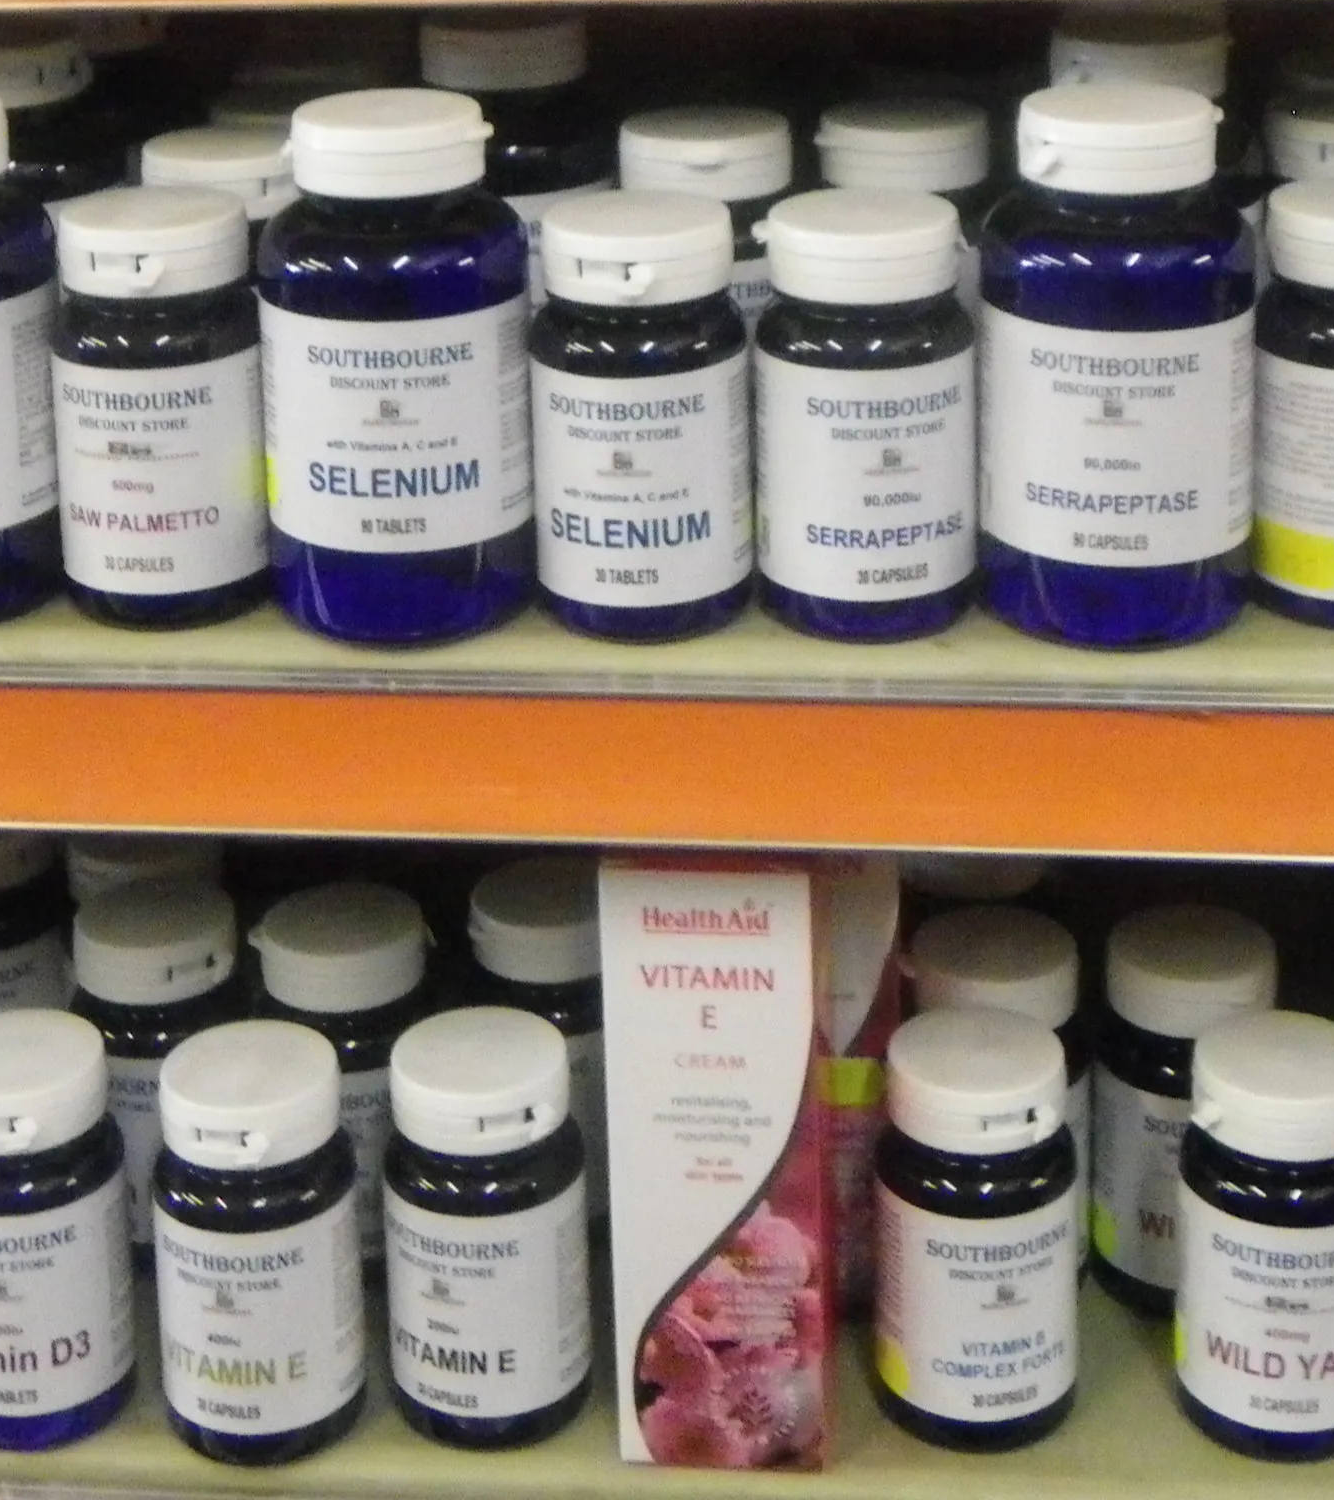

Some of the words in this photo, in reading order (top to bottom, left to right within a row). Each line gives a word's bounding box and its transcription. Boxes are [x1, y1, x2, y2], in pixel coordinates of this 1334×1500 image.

[307, 342, 474, 370] SOUTHBOURNE
[1030, 348, 1200, 378] SOUTHBOURNE
[329, 376, 398, 391] DISCOUNT
[403, 374, 450, 390] STORE
[1052, 380, 1124, 397] DISCOUNT
[1128, 384, 1176, 397] STORE
[63, 385, 213, 411] SOUTHBOURNE
[550, 392, 705, 422] SOUTHBOURNE
[806, 384, 961, 420] SOUTHBOURNE
[428, 439, 447, 449] and
[635, 425, 683, 441] STORE
[309, 459, 481, 498] SELENIUM
[1026, 482, 1199, 515] SERRAPEPTASE
[70, 505, 102, 527] SAW
[107, 505, 219, 533] PALMETTO
[375, 517, 427, 535] TABLETS
[551, 508, 711, 549] SELENIUM
[806, 510, 963, 549] SERRAPEPTASE
[1087, 532, 1148, 551] CAPSULES
[117, 556, 174, 572] CAPSULES
[609, 568, 659, 586] TABLETS
[640, 964, 775, 991] VITAMIN
[701, 1005, 717, 1030] E
[674, 1054, 747, 1068] CREAM
[745, 1115, 771, 1126] and
[676, 1131, 750, 1146] nourishing
[51, 1331, 91, 1367] D3
[393, 1326, 487, 1374] VITAMIN
[498, 1349, 517, 1373] E
[962, 1336, 1027, 1357] VITAMIN
[1206, 1329, 1285, 1382] WILD
[167, 1344, 276, 1387] VITAMIN
[288, 1351, 307, 1380] E
[932, 1355, 1017, 1378] COMPLEX
